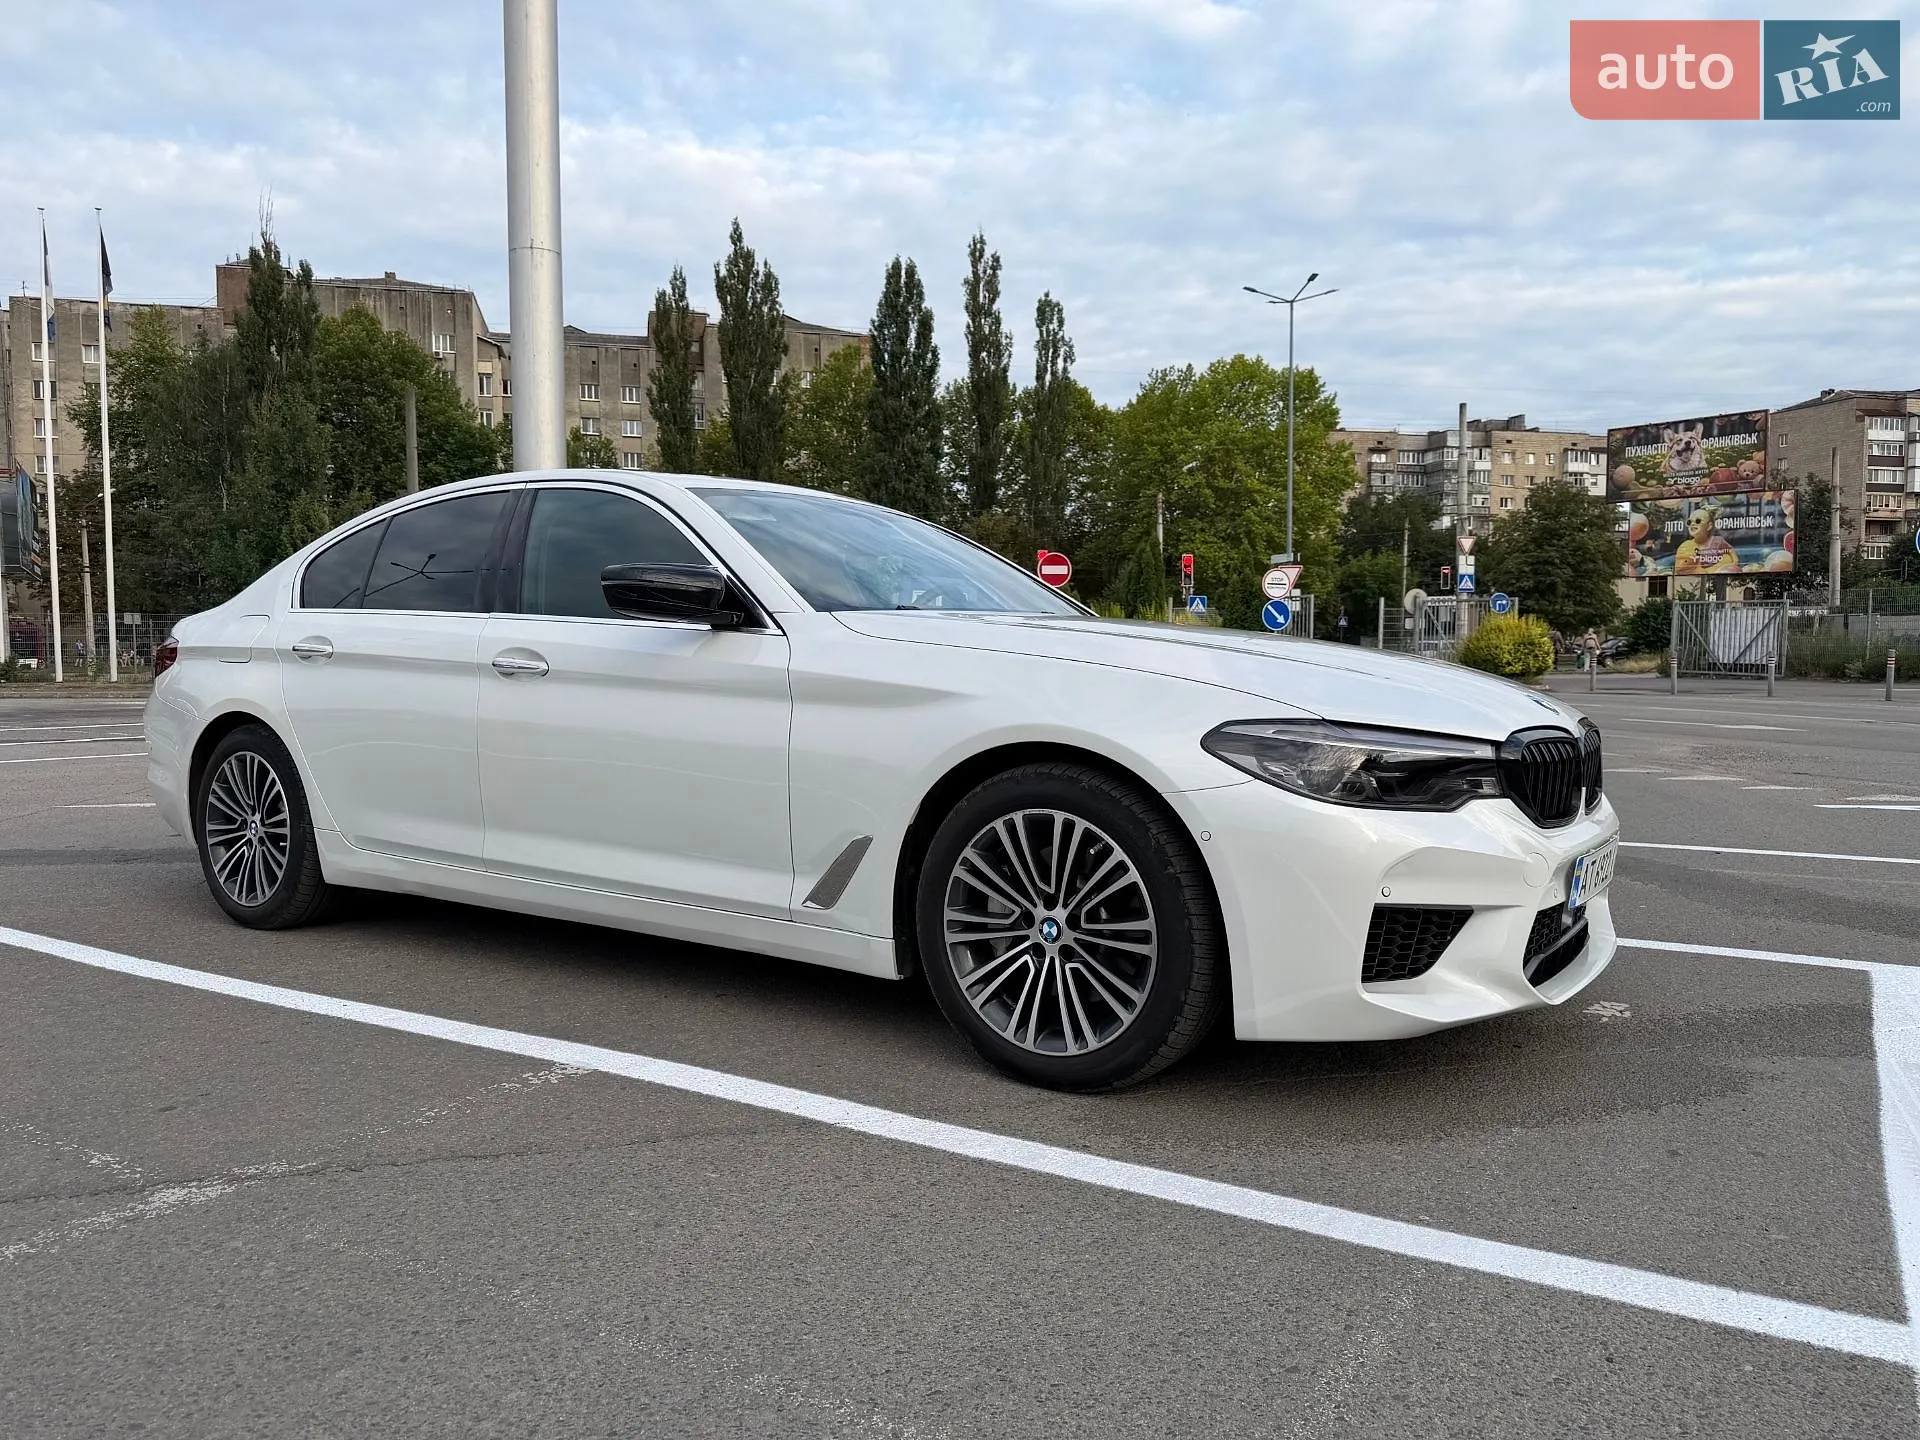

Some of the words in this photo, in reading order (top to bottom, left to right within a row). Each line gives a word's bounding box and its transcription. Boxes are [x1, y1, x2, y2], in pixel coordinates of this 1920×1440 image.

[1625, 443, 1669, 458] ПУХНАСТО
[1700, 432, 1758, 448] ФРАНКІВСЬК
[1677, 476, 1701, 485] blago
[1664, 520, 1684, 532] ЛІТО
[1714, 515, 1773, 529] ФРАНКІВСЬК
